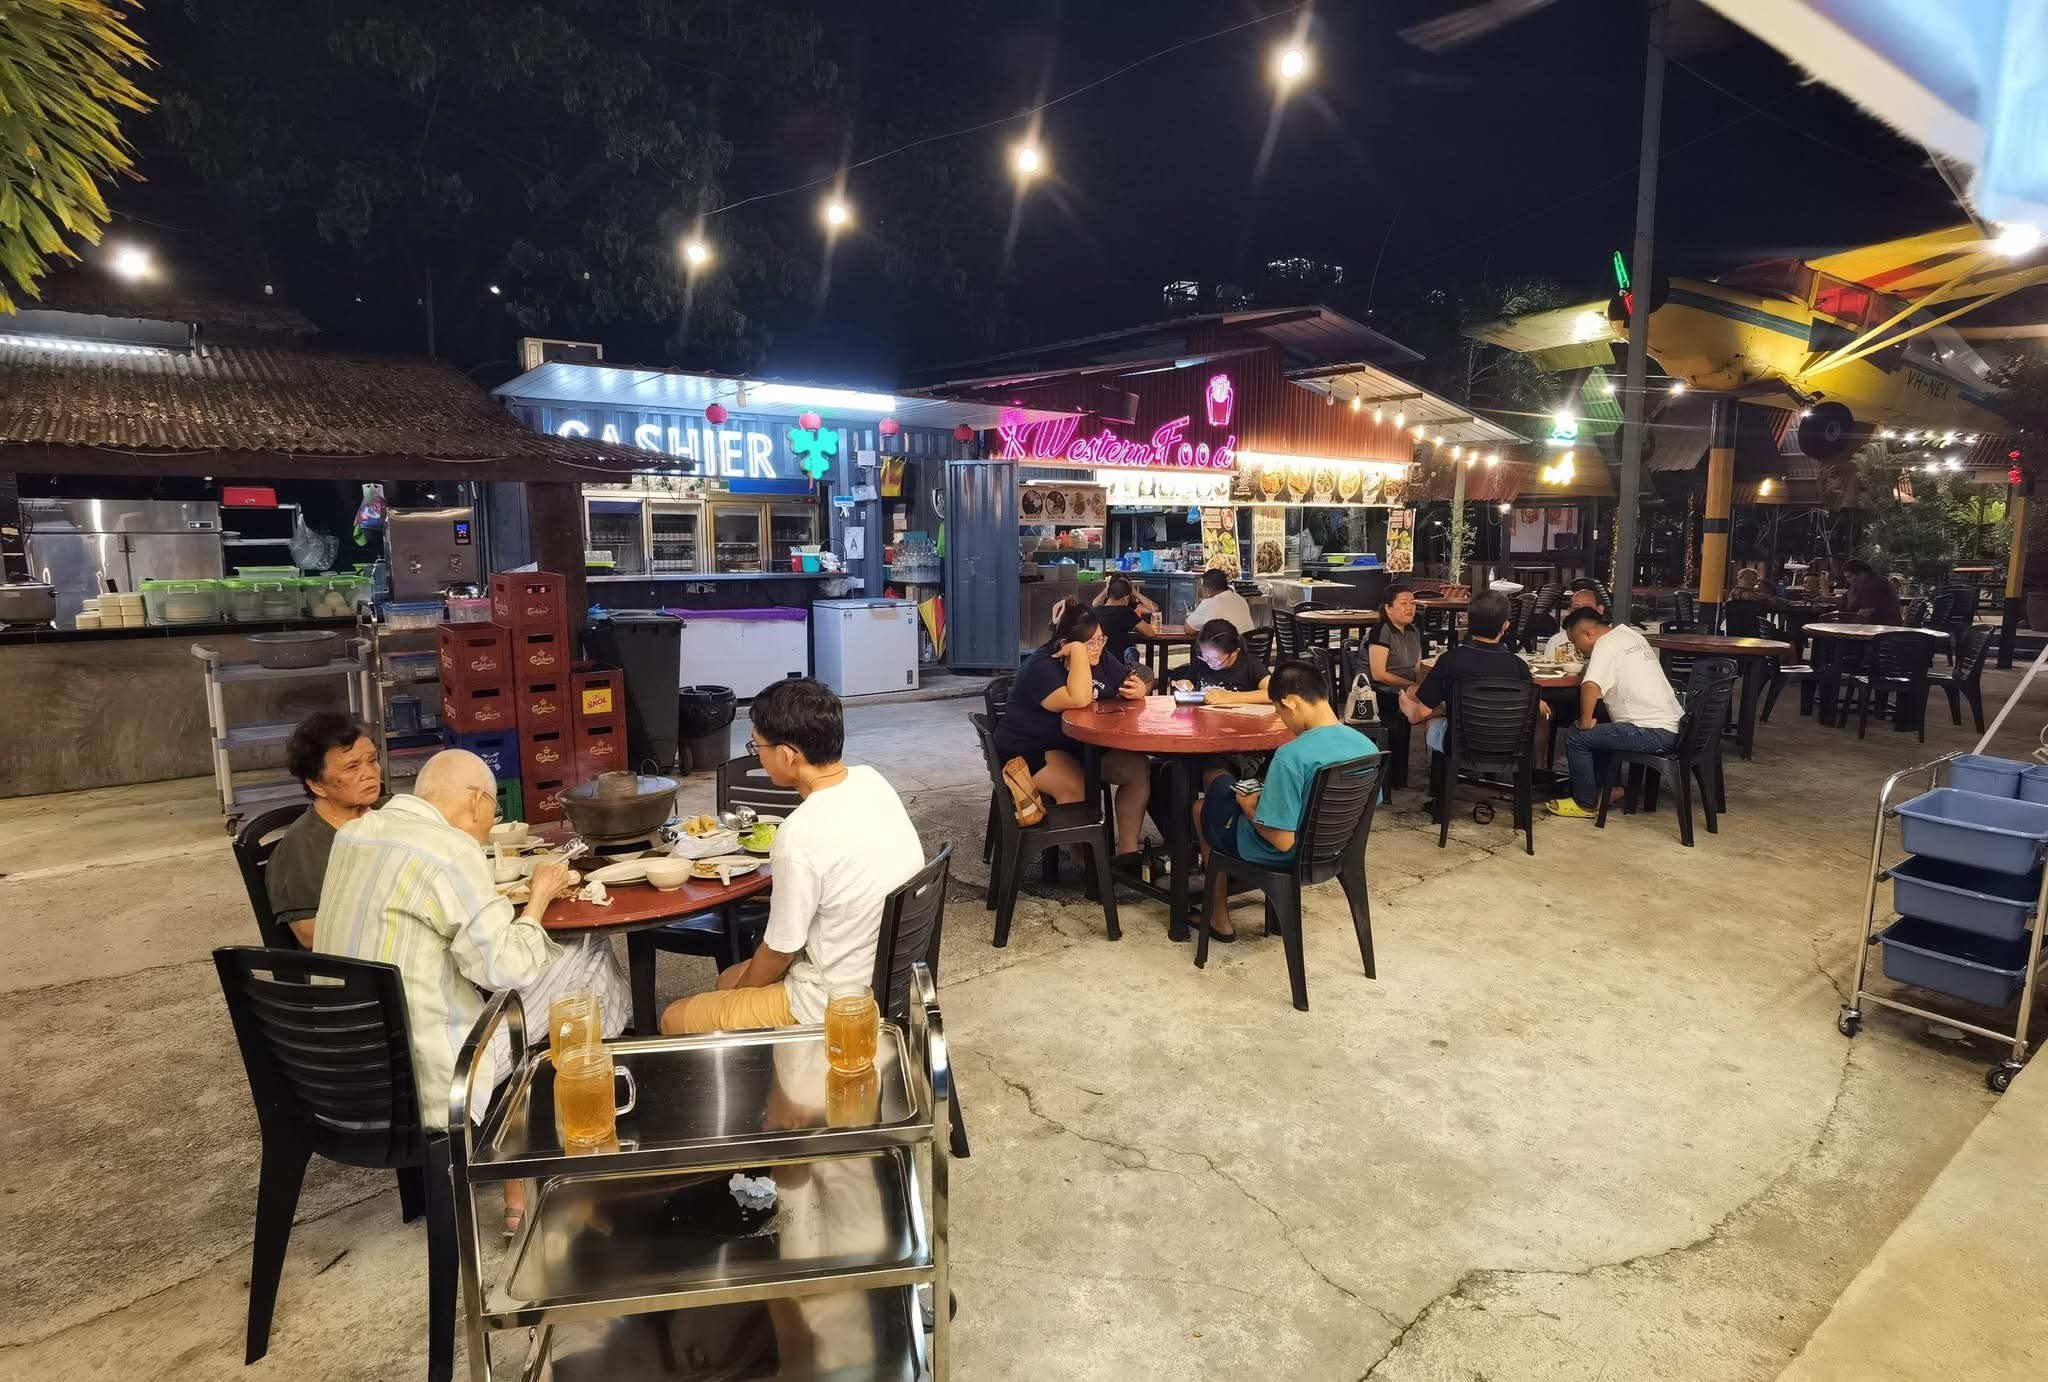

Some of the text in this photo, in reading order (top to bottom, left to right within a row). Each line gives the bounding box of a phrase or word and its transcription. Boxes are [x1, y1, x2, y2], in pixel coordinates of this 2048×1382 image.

[1906, 369, 1951, 401] VH-NEX
[1021, 415, 1236, 468] Western Food
[850, 538, 858, 551] A
[529, 654, 555, 666] Carlsberg
[531, 703, 556, 715] Carlsberg
[587, 697, 608, 709] SKOL
[535, 751, 560, 763] Carlsberg
[539, 800, 561, 811] Carlsber
